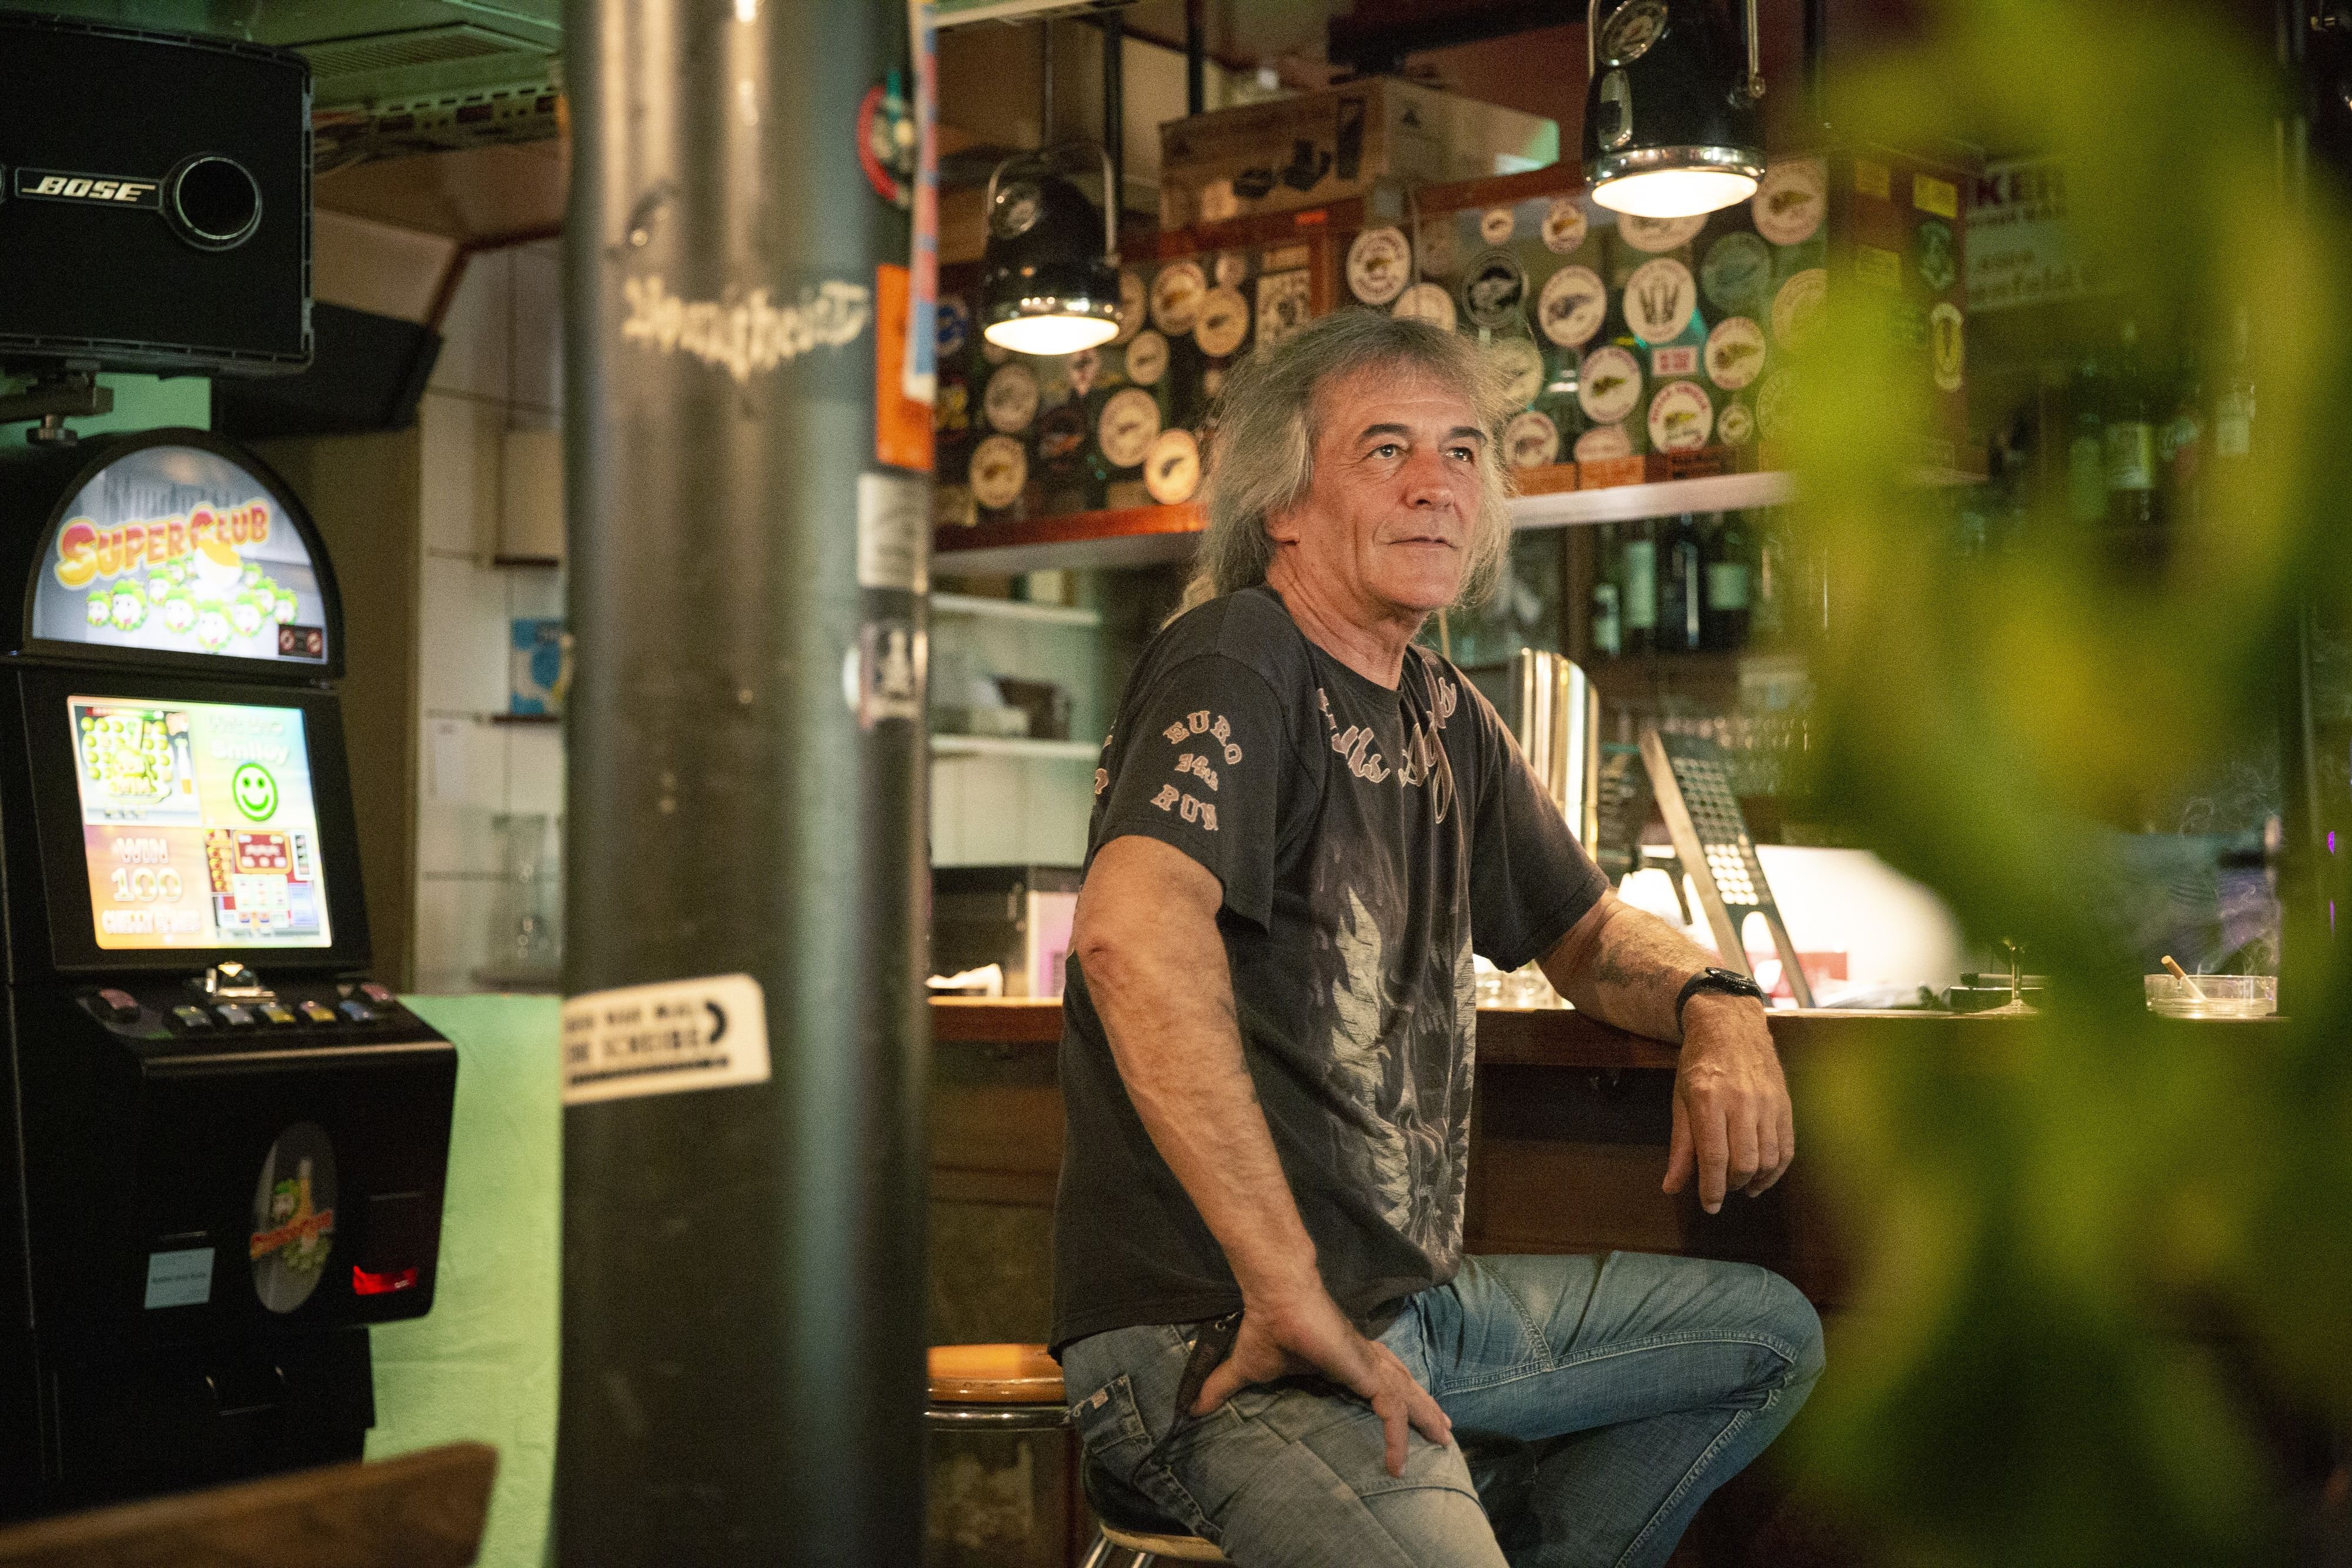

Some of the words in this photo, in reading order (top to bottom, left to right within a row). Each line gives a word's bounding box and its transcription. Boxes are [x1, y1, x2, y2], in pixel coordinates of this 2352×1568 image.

[22, 176, 156, 202] BOSE
[57, 517, 188, 587] SUPER
[1162, 710, 1242, 764] EURO
[1150, 784, 1219, 831] RUN
[115, 837, 169, 864] WIN
[111, 867, 183, 902] 100
